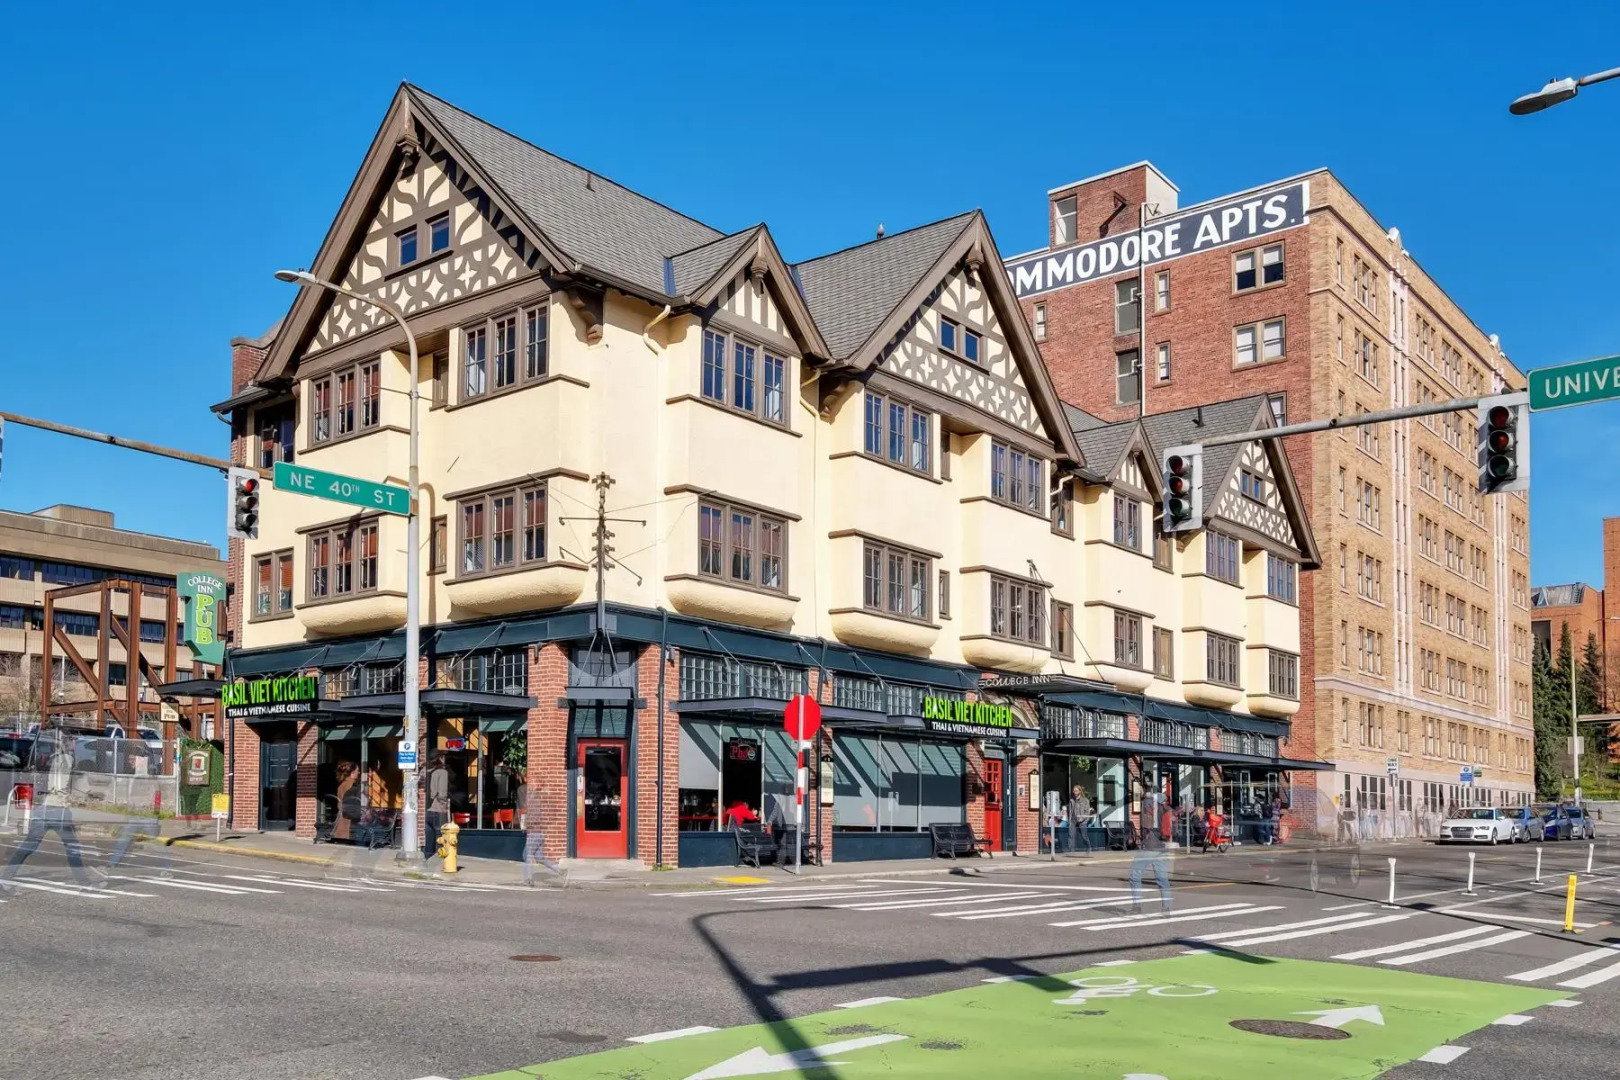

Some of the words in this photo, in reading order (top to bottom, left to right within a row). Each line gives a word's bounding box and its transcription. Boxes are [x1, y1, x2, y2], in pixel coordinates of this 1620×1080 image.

[1193, 194, 1296, 249] APTS.
[290, 472, 315, 490] NE
[329, 481, 360, 497] 40TH
[374, 489, 396, 506] ST
[187, 576, 223, 590] COLLEGE
[197, 585, 213, 593] INN
[196, 594, 214, 645] PUB
[222, 682, 248, 706] BASIL
[250, 680, 271, 704] VIET
[272, 676, 315, 702] KITCHEN
[228, 707, 243, 717] THAI
[249, 704, 286, 716] VIETNAMESE
[286, 702, 311, 713] CUISINE
[924, 696, 953, 720] BASIL
[954, 700, 975, 723] VIET
[975, 703, 1013, 727] KITCHEN
[933, 721, 947, 731] THAI
[952, 723, 986, 735] VIETNAMESE
[986, 726, 1007, 738] CUISINE
